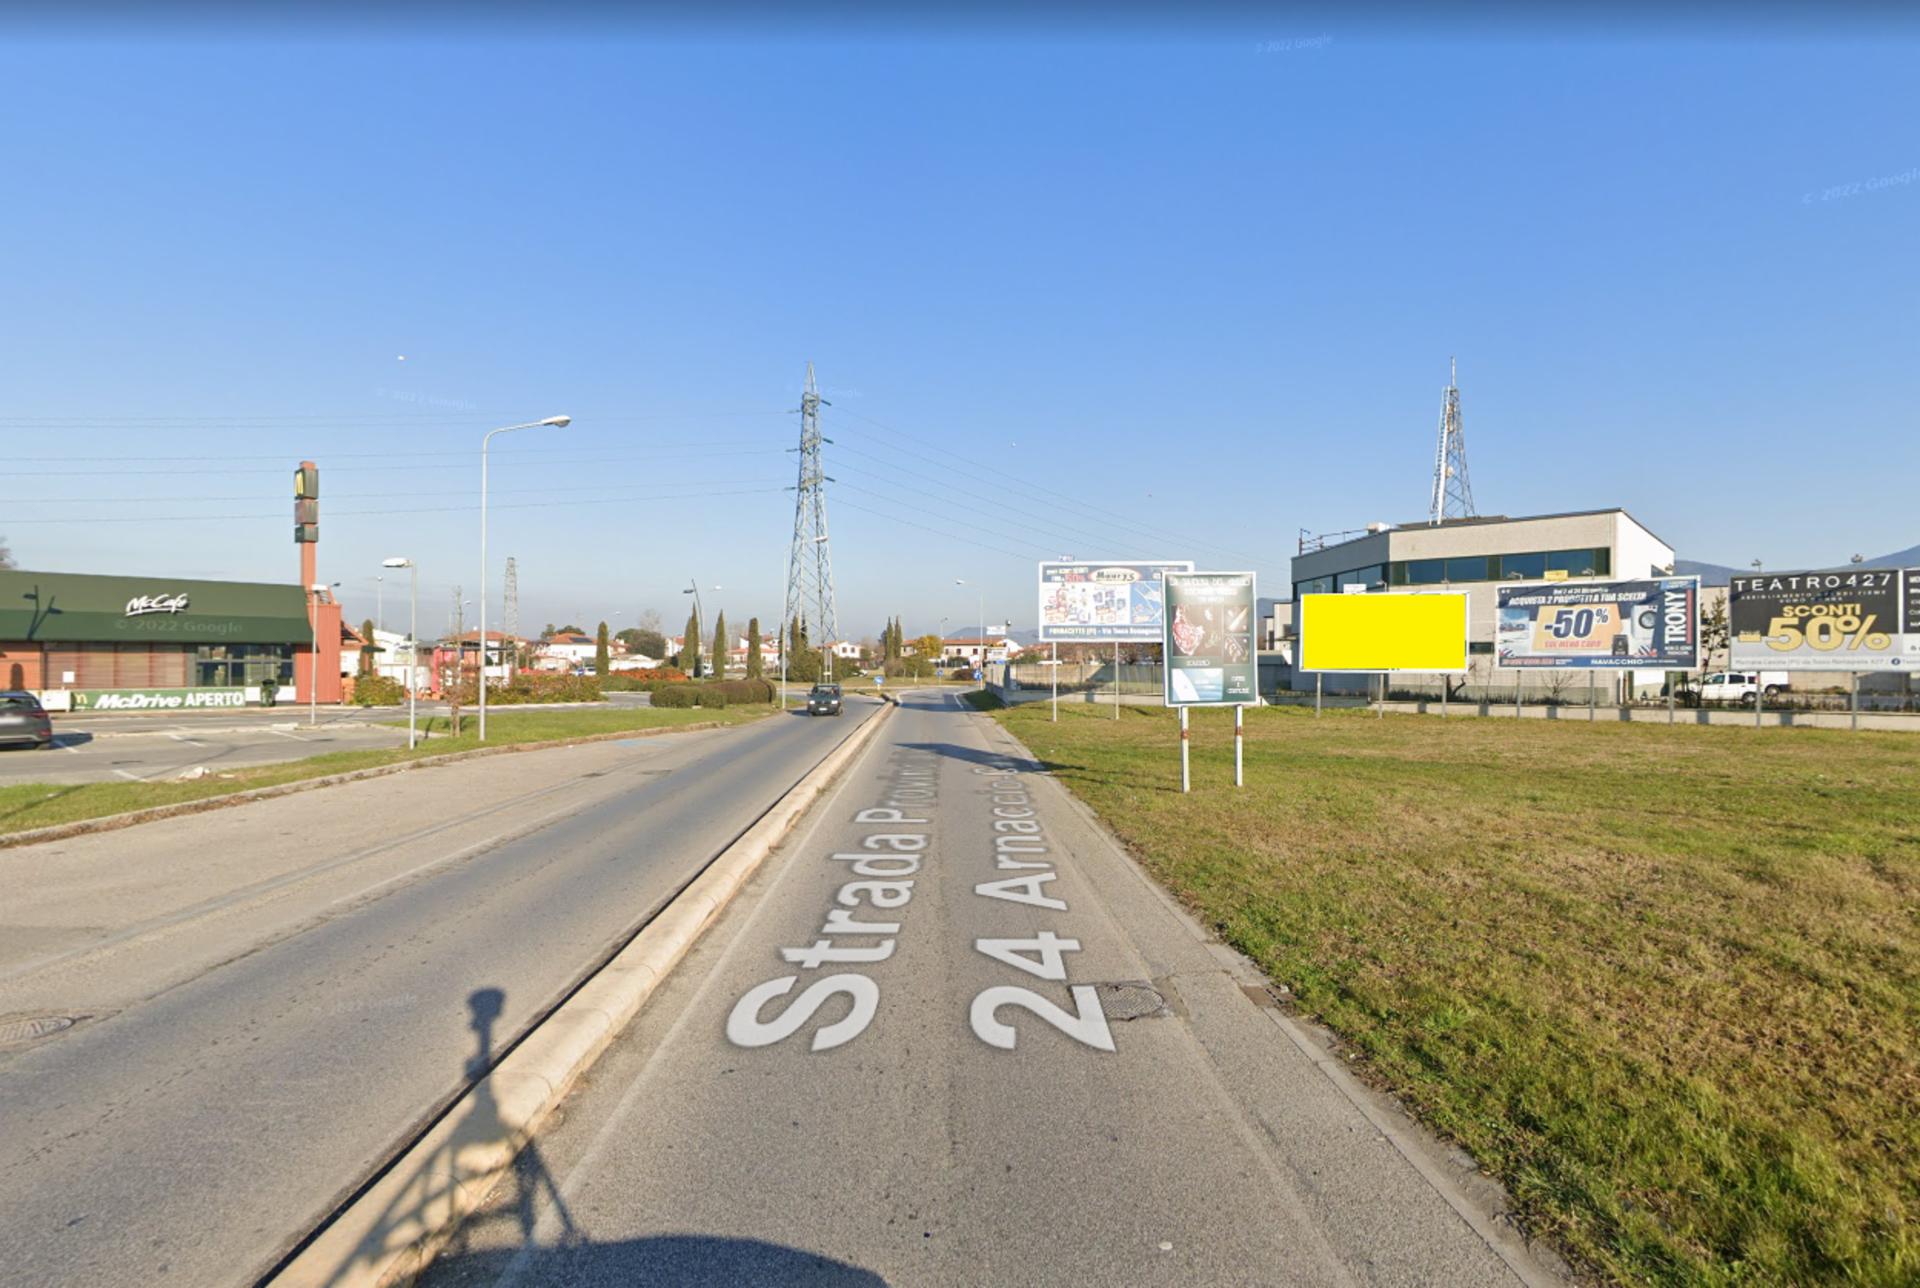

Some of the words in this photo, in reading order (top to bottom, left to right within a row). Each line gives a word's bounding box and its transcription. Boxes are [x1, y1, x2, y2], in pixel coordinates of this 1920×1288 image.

[1664, 591, 1687, 645] TRONY
[1782, 604, 1861, 617] SCONTI
[1544, 608, 1609, 639] -50%
[1590, 658, 1644, 666] NAVACCHIO
[94, 694, 182, 710] McDrive
[184, 690, 244, 707] APERTO
